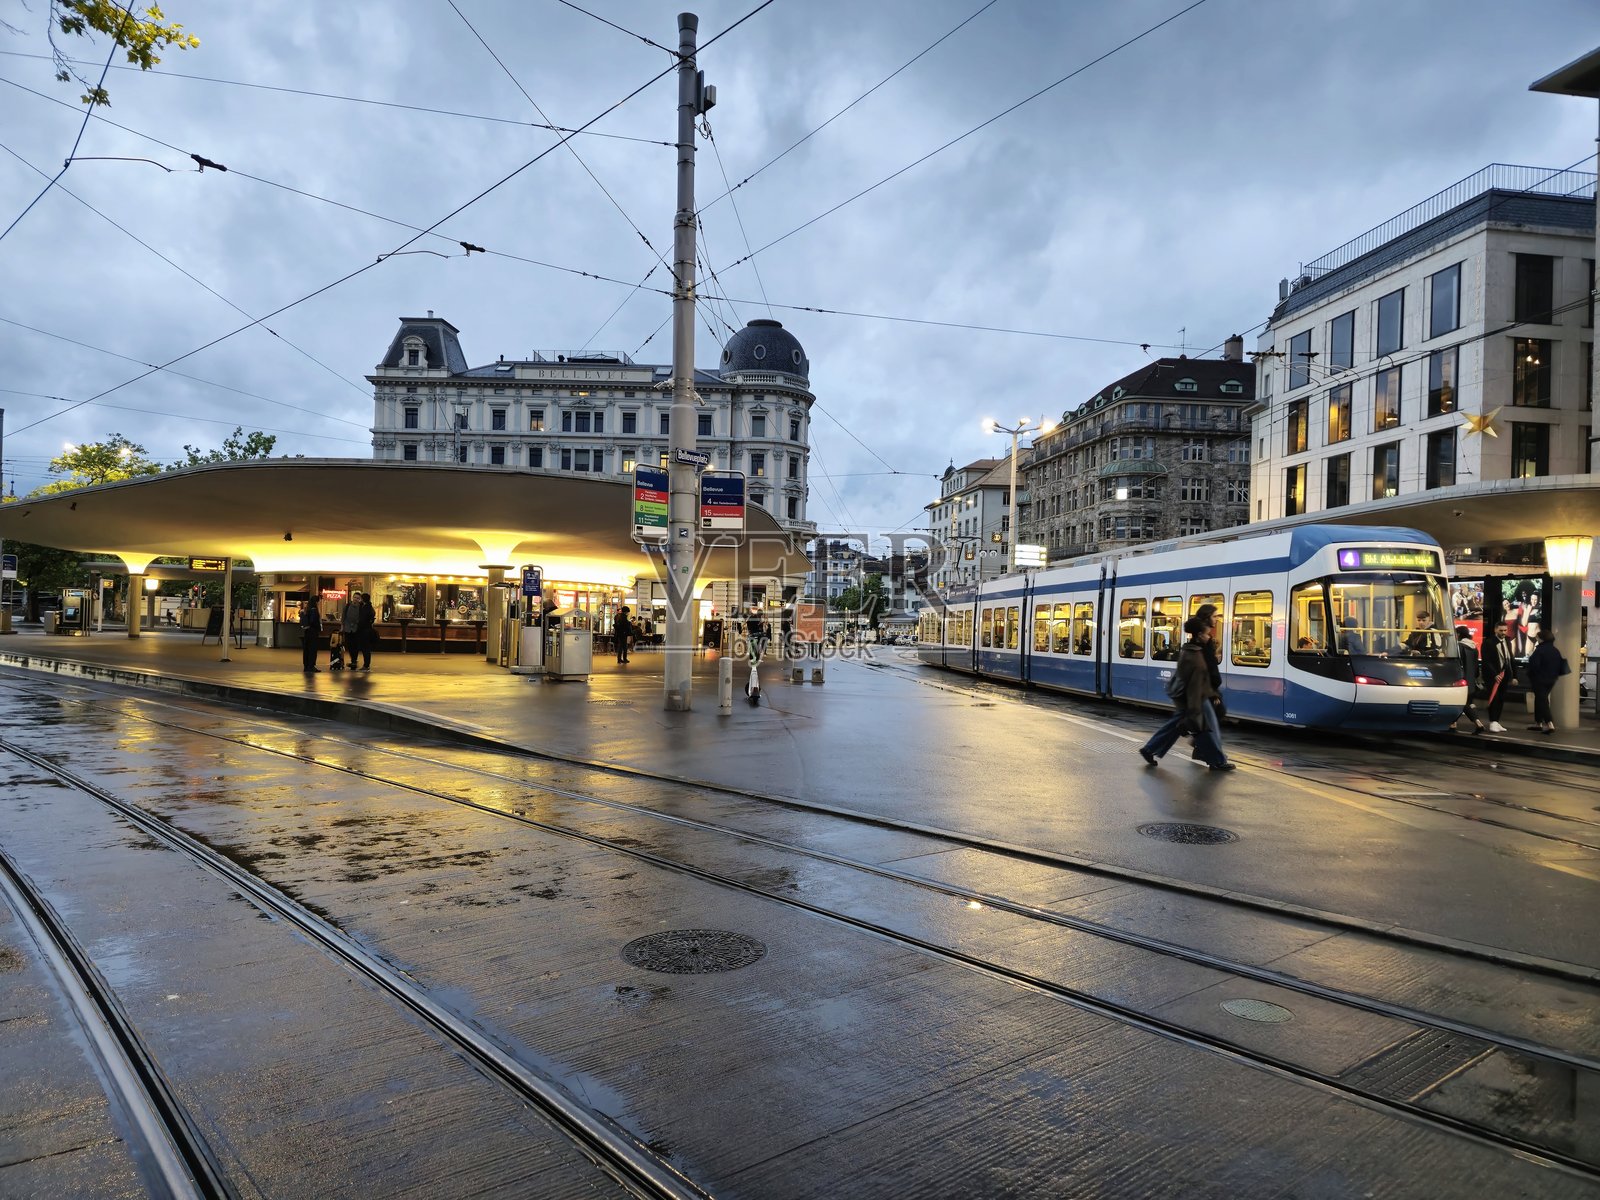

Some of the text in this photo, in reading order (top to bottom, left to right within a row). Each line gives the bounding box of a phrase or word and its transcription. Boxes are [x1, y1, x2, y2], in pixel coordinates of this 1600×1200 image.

[677, 449, 708, 464] Bellevueplatz
[637, 480, 653, 488] Bellevue
[640, 492, 645, 500] 2
[639, 504, 645, 512] 8
[638, 516, 644, 524] 11
[1343, 552, 1432, 566] 4 Bhf. Altstetten Nord
